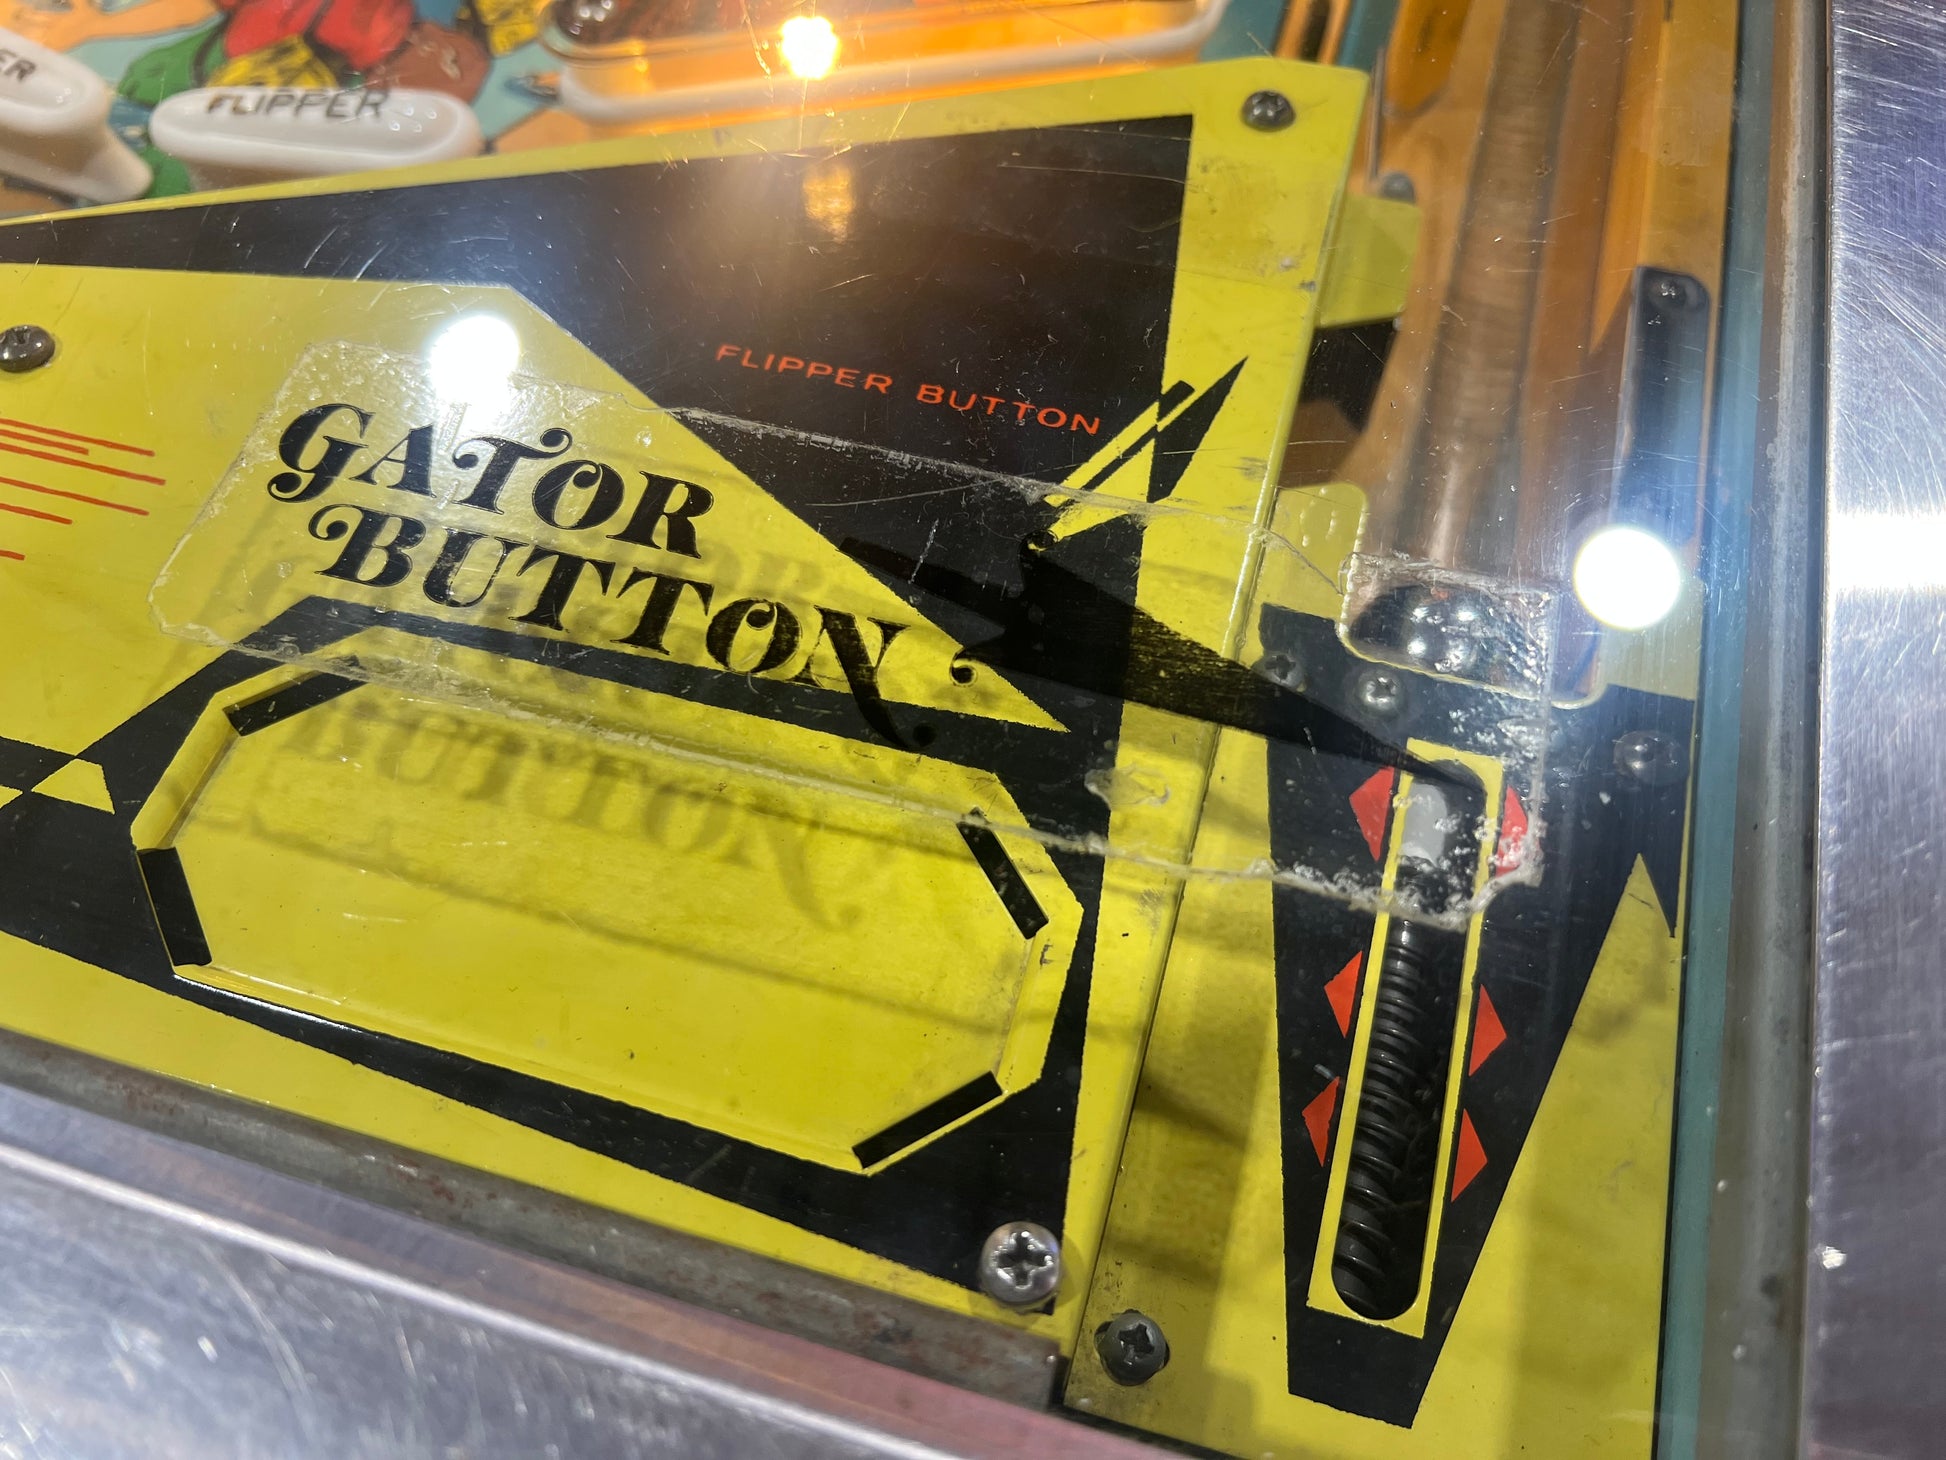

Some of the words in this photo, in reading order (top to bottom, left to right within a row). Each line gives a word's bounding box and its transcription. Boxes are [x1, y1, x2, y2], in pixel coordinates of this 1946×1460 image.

[207, 88, 390, 118] FLIPPER
[715, 344, 893, 394] FLIPPER
[915, 384, 1100, 435] BUTTON
[267, 403, 715, 559] GATOR
[308, 503, 937, 751] BUTTON
